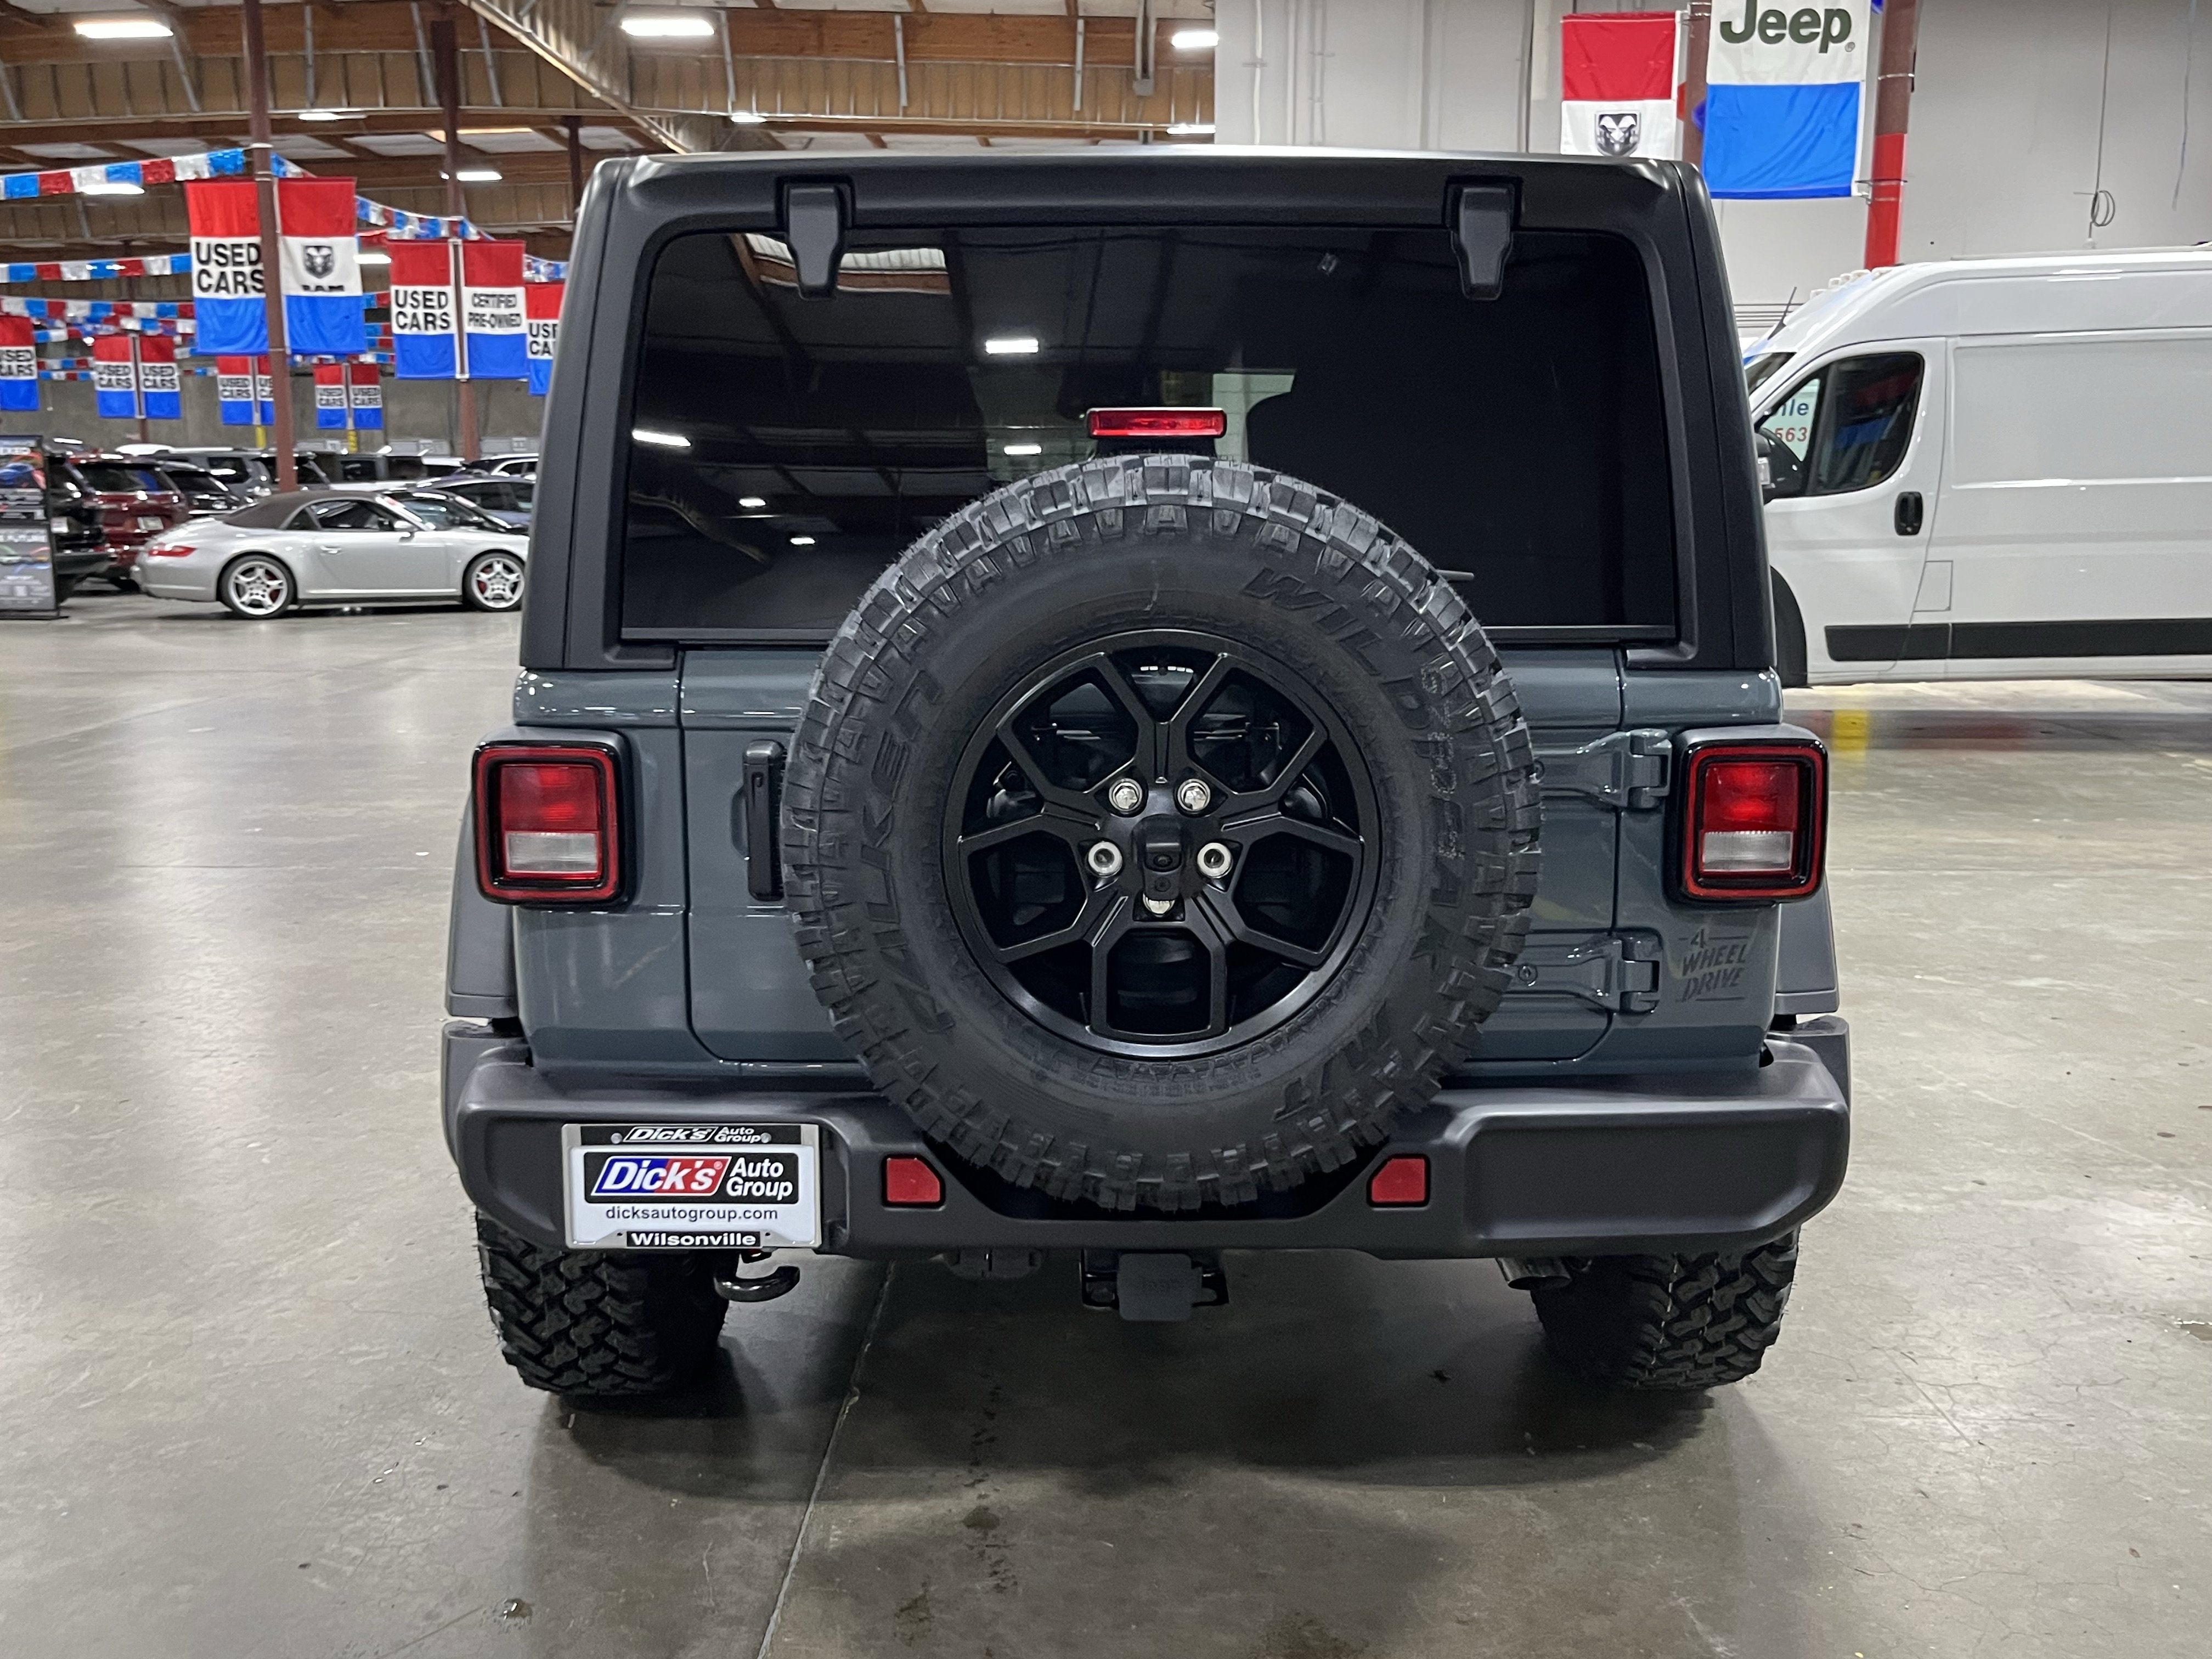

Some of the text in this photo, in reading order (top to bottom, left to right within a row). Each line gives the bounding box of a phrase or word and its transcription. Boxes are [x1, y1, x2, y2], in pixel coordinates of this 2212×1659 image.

[1720, 0, 1852, 54] Jeep
[195, 242, 261, 266] USED
[197, 269, 264, 294] CARS
[302, 284, 345, 292] RAM
[394, 289, 449, 309] USED
[471, 293, 517, 308] CERTIFIED
[395, 311, 451, 330] CARS
[468, 312, 522, 328] PRE-OWNED
[97, 365, 132, 376] USED
[142, 365, 176, 376] USED
[98, 377, 132, 388] CARS
[143, 378, 177, 389] CARS
[219, 377, 250, 387] USED
[220, 389, 252, 398] CARS
[317, 387, 343, 396] USED
[352, 387, 381, 396] USED
[318, 397, 344, 407] CARS
[353, 397, 381, 406] CARS
[1681, 944, 1747, 977] WHEEL
[1681, 967, 1746, 1002] DRIVE
[629, 1126, 755, 1141] Dick's Auto
[714, 1133, 761, 1144] Group
[602, 1158, 784, 1191] Dick's Auto
[725, 1177, 793, 1200] Group
[606, 1206, 778, 1222] dicksautogroup.com
[630, 1232, 757, 1246] Wilsonville
